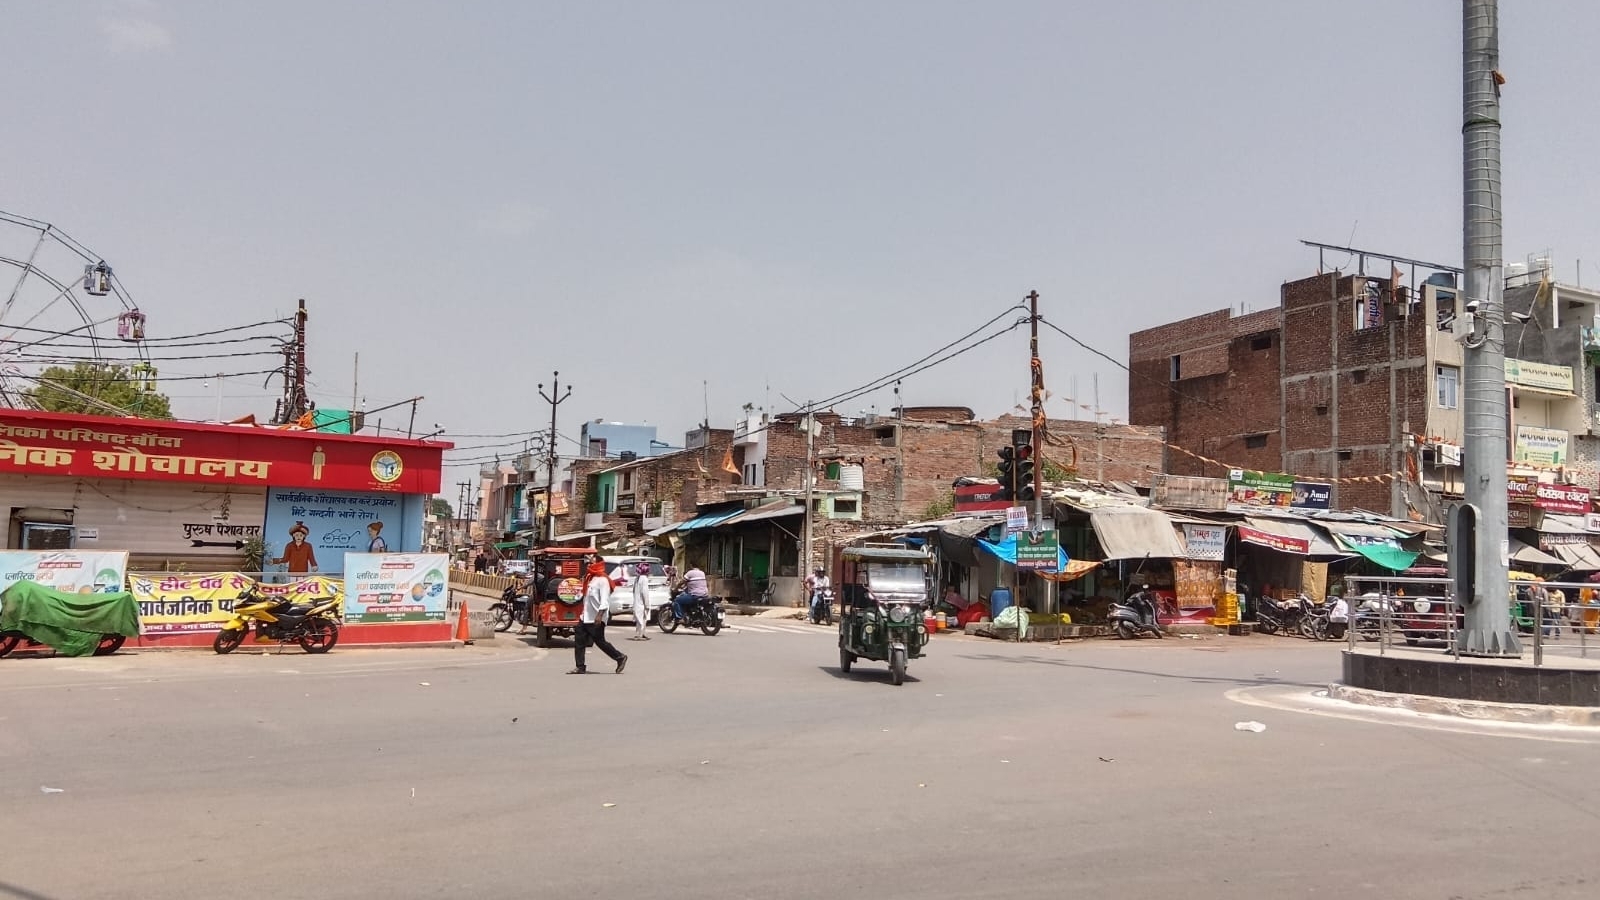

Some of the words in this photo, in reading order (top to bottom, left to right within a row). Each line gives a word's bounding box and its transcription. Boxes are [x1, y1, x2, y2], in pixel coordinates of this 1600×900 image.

[92, 446, 272, 479] शौचालय
[1309, 490, 1329, 499] Amul
[182, 523, 215, 539] पुरुष
[4, 570, 36, 581] प्लास्टिक
[159, 576, 192, 592] हीट
[229, 575, 245, 590] से
[138, 595, 214, 616] सार्वजनिक
